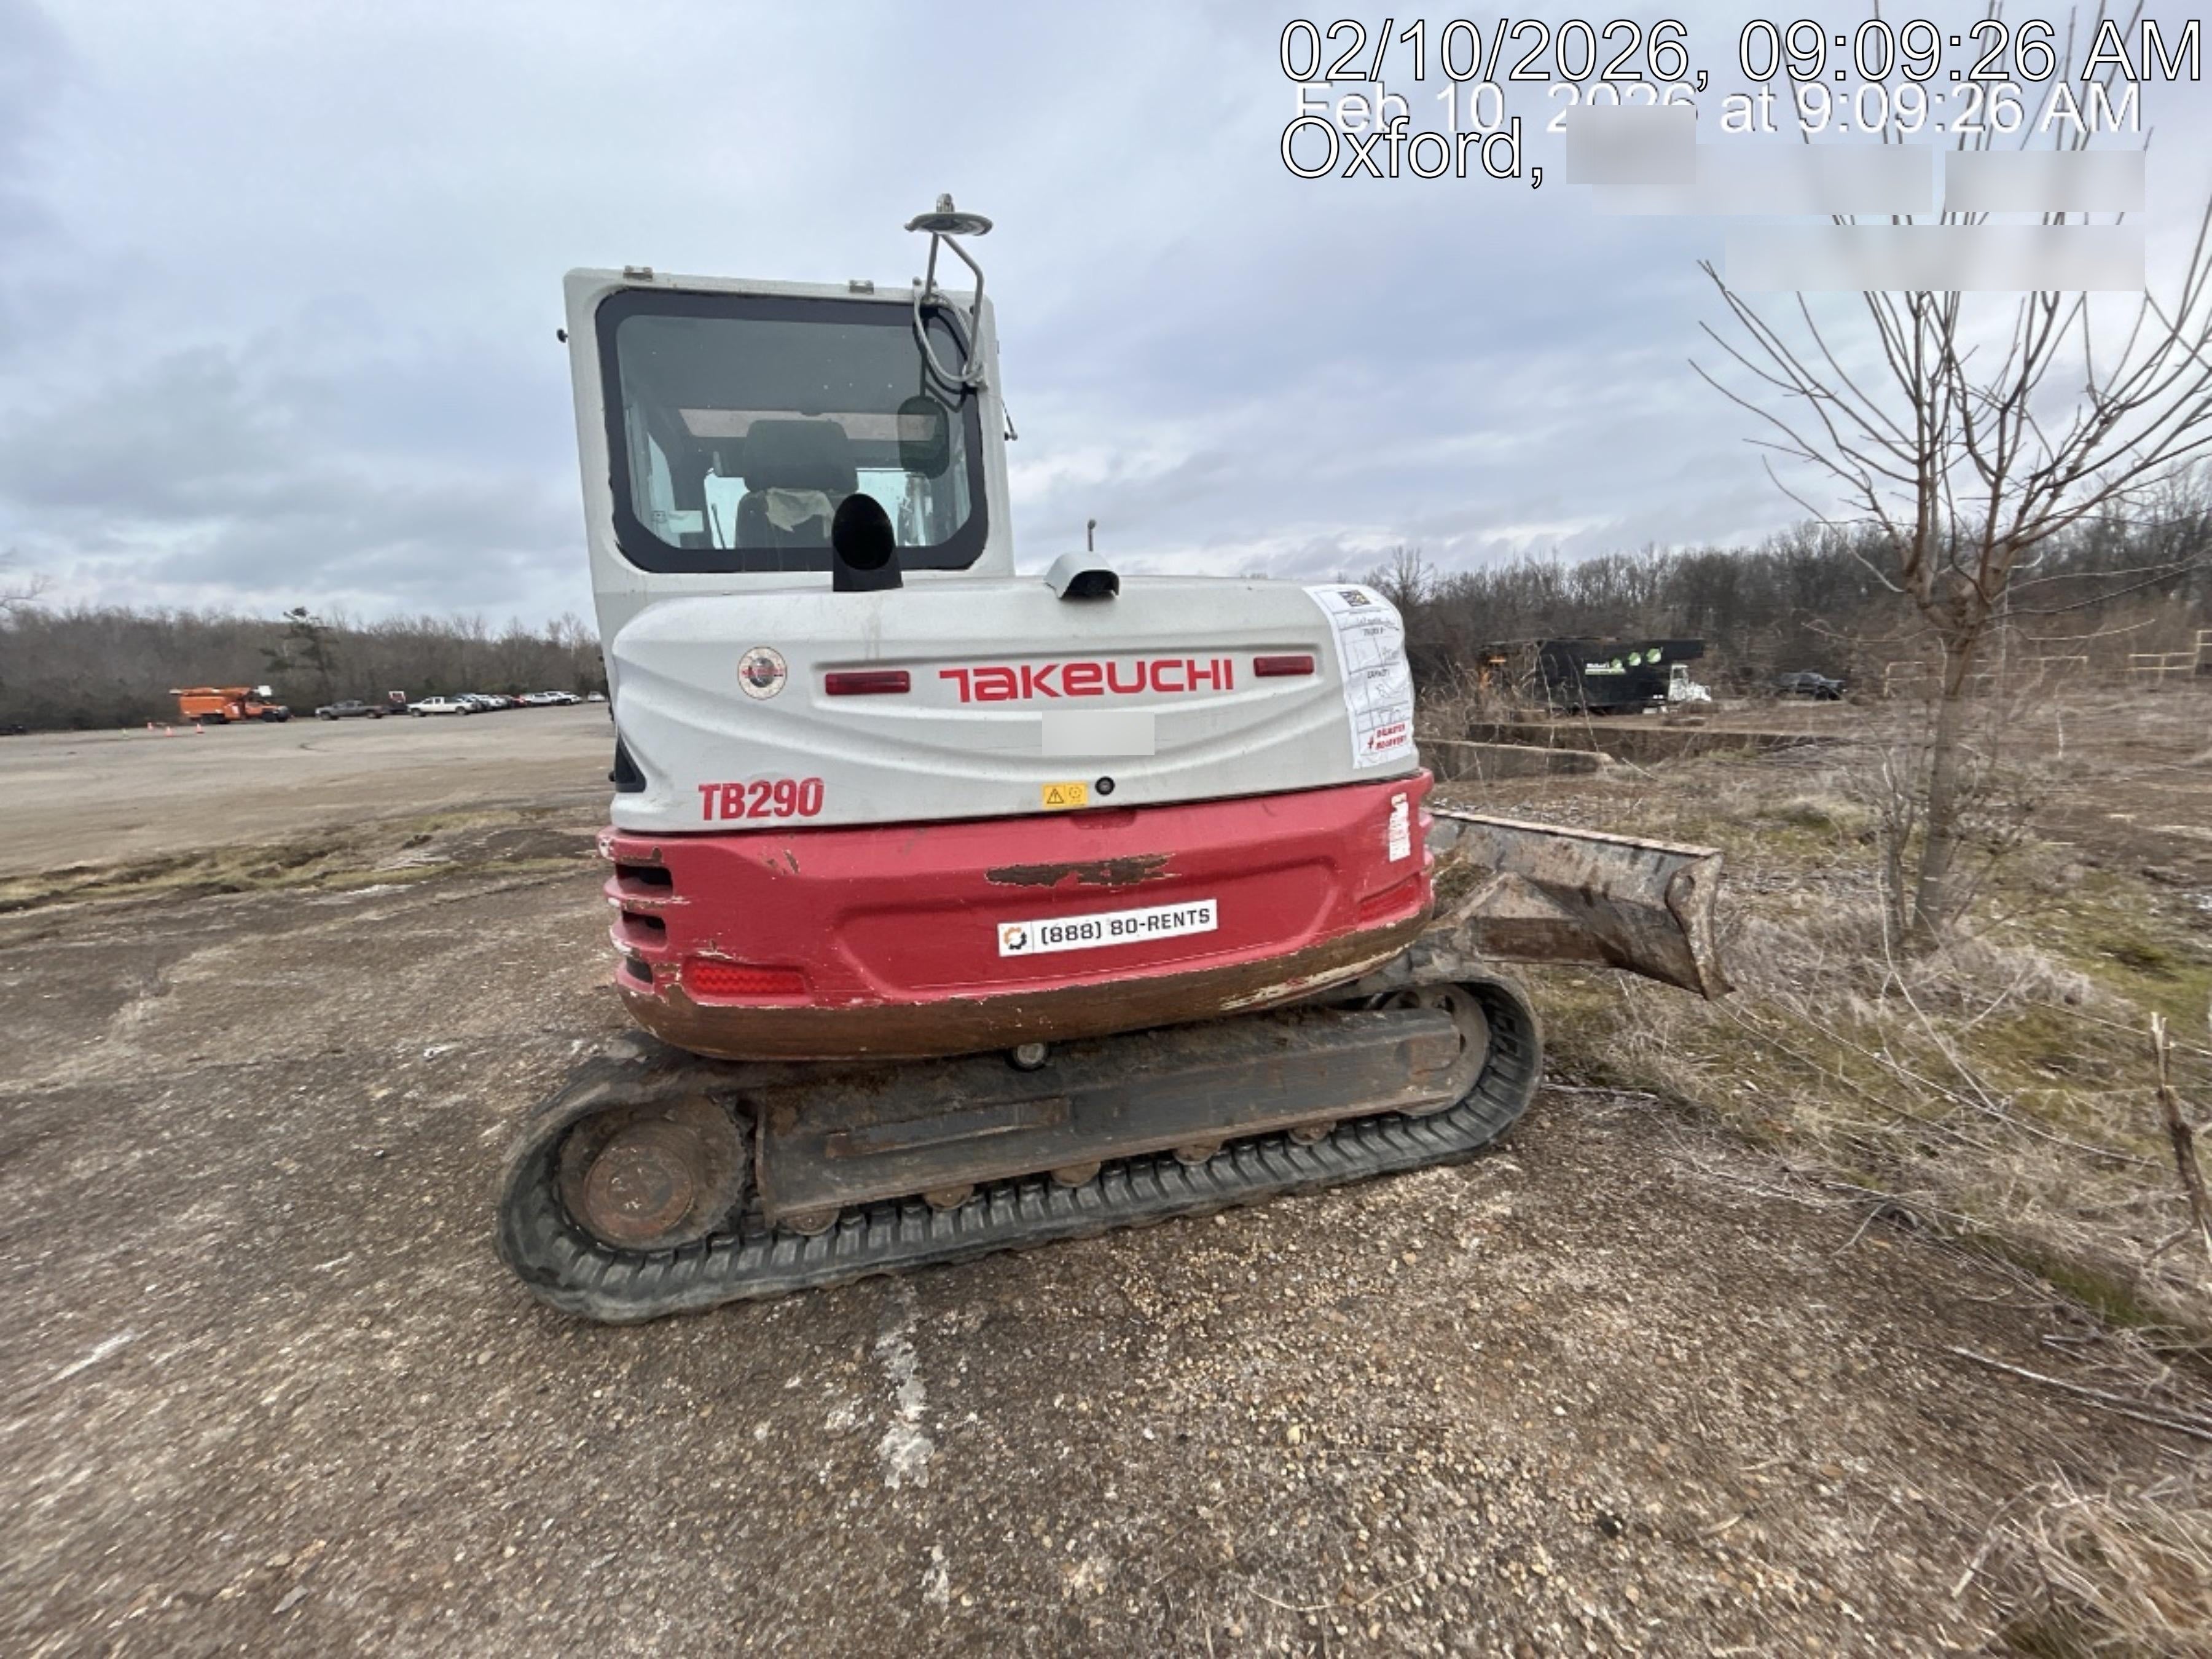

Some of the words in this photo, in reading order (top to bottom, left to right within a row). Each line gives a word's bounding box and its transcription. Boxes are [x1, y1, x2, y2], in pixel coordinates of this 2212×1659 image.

[939, 659, 1234, 703] TAKEUCHI
[698, 777, 824, 821] TB290
[1041, 921, 1102, 944] (888)
[1110, 908, 1210, 936] 80-RENTS
